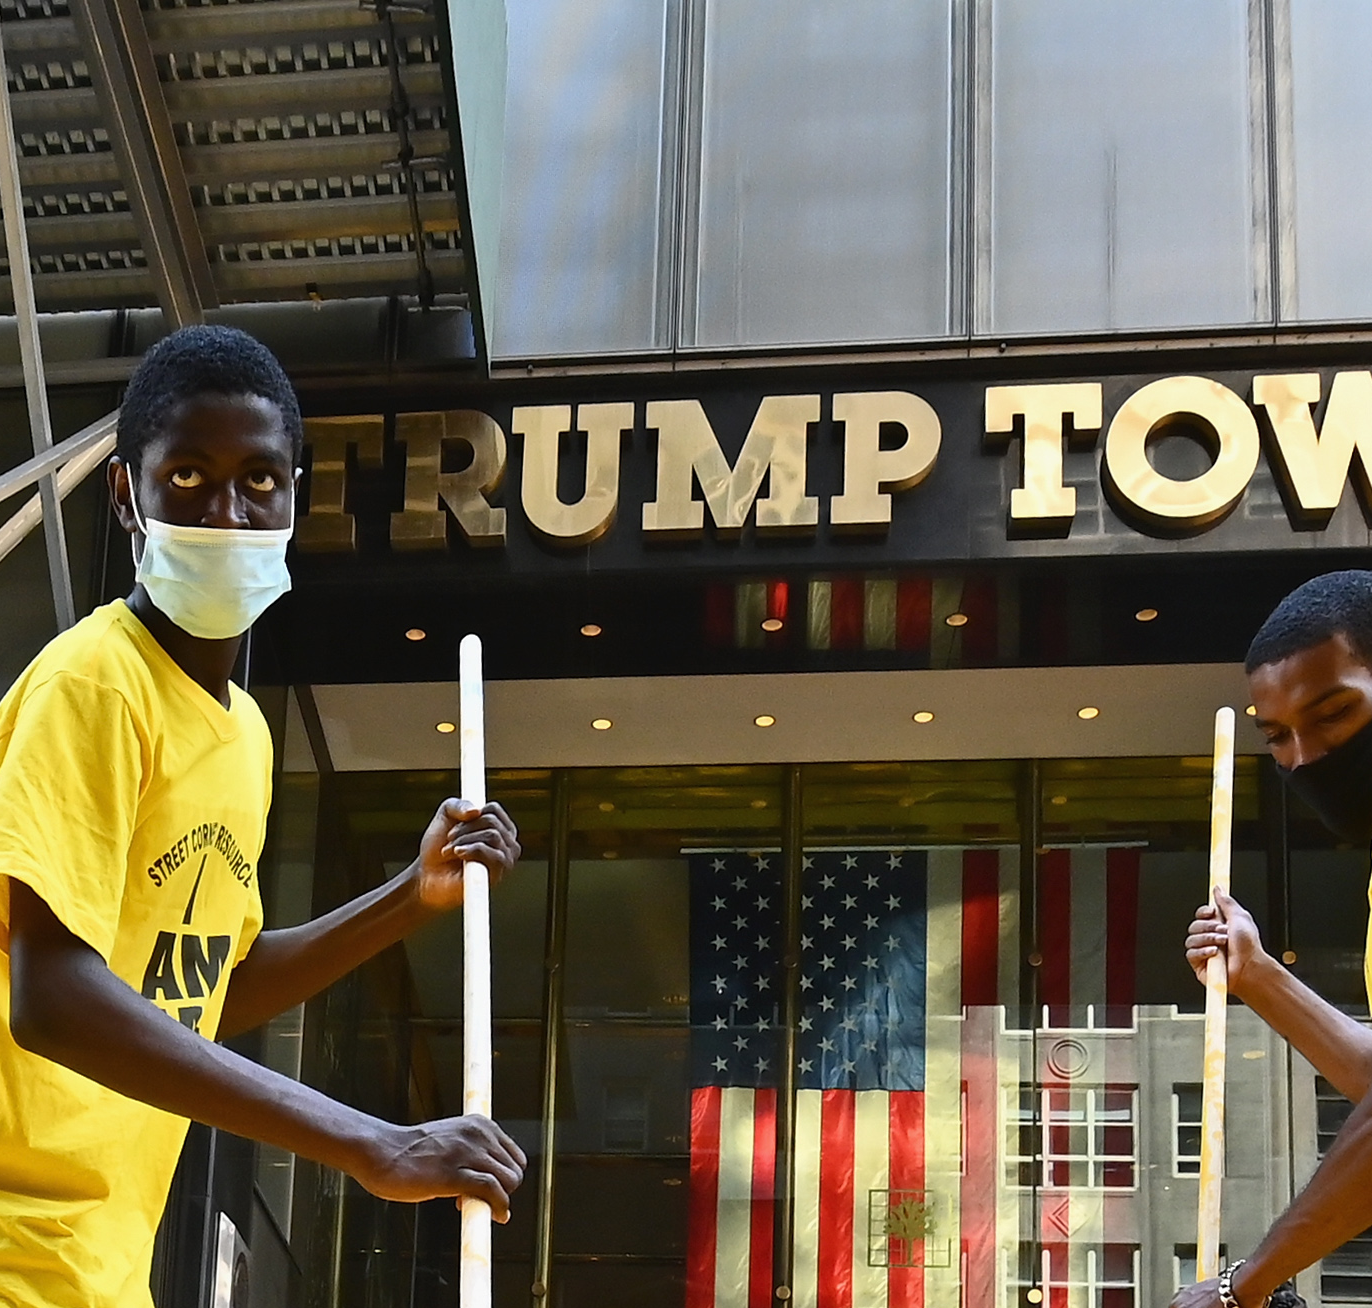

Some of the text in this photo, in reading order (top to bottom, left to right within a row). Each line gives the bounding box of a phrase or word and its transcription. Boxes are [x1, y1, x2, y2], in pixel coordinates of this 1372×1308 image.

[295, 390, 943, 555] TRUMP
[148, 833, 190, 888] STREET
[182, 852, 208, 926] I
